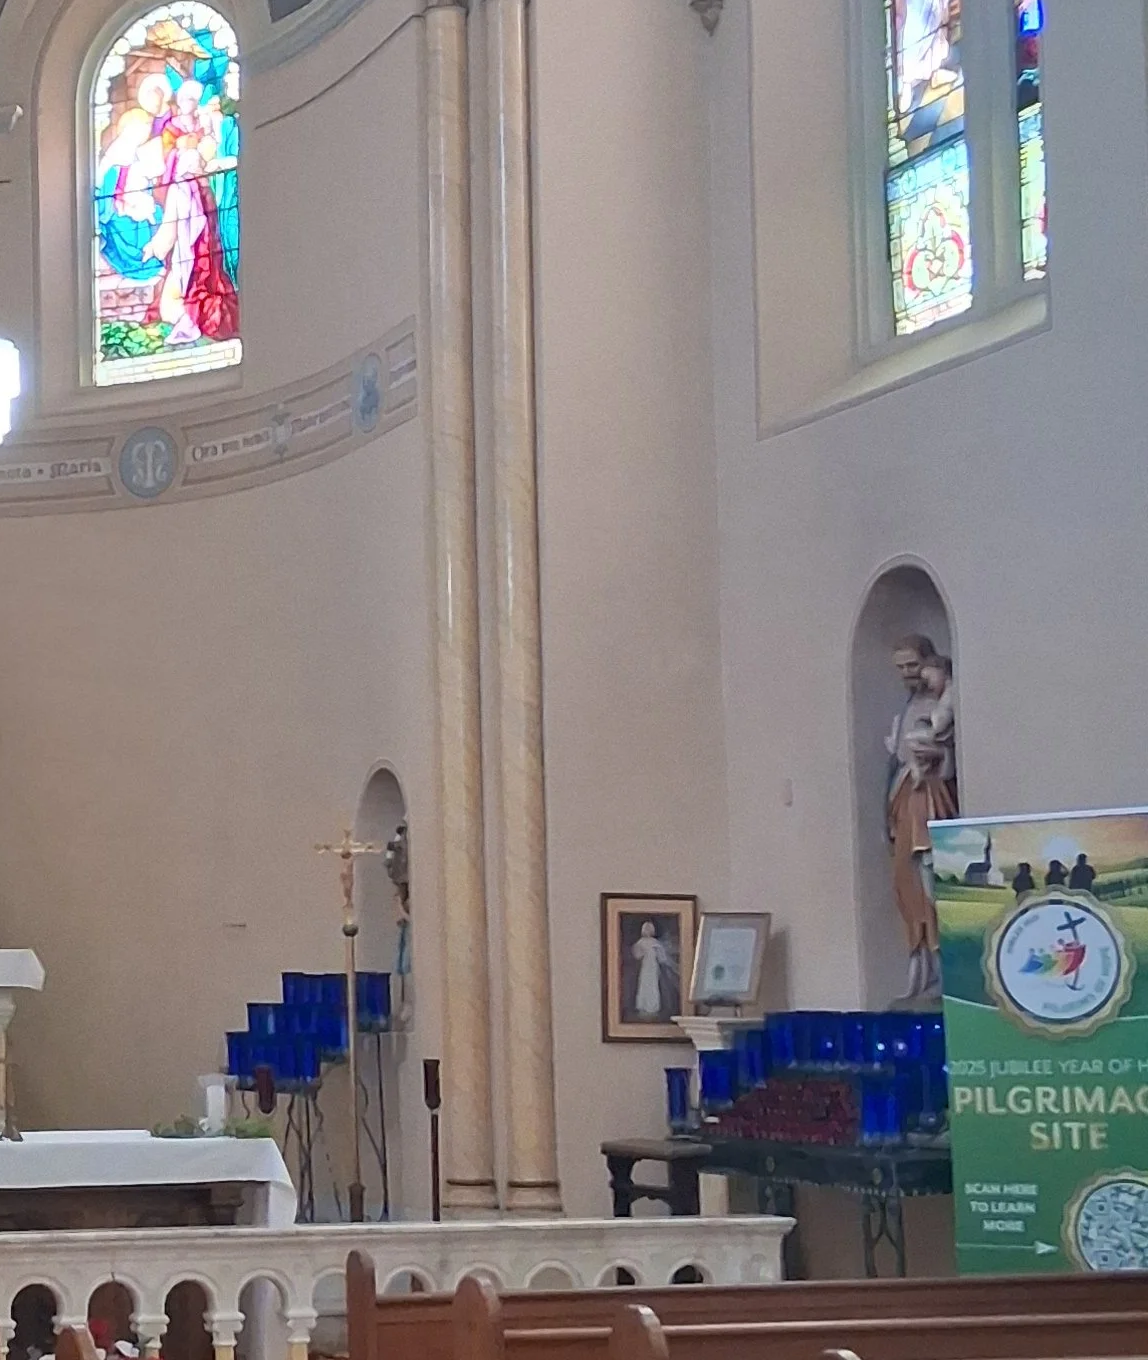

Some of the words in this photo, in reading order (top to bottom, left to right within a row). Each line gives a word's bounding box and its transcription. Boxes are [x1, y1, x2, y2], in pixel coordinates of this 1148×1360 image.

[949, 1059, 986, 1076] 2025
[989, 1059, 1053, 1079] JUBILEE
[1058, 1059, 1104, 1075] YEAR
[1107, 1058, 1133, 1075] OF
[1029, 1121, 1109, 1151] SITE
[964, 1183, 1001, 1195] SCAN
[1003, 1183, 1038, 1196] HERE
[970, 1201, 989, 1213] TO
[991, 1201, 1036, 1213] LEARN
[983, 1220, 1025, 1233] MORE
